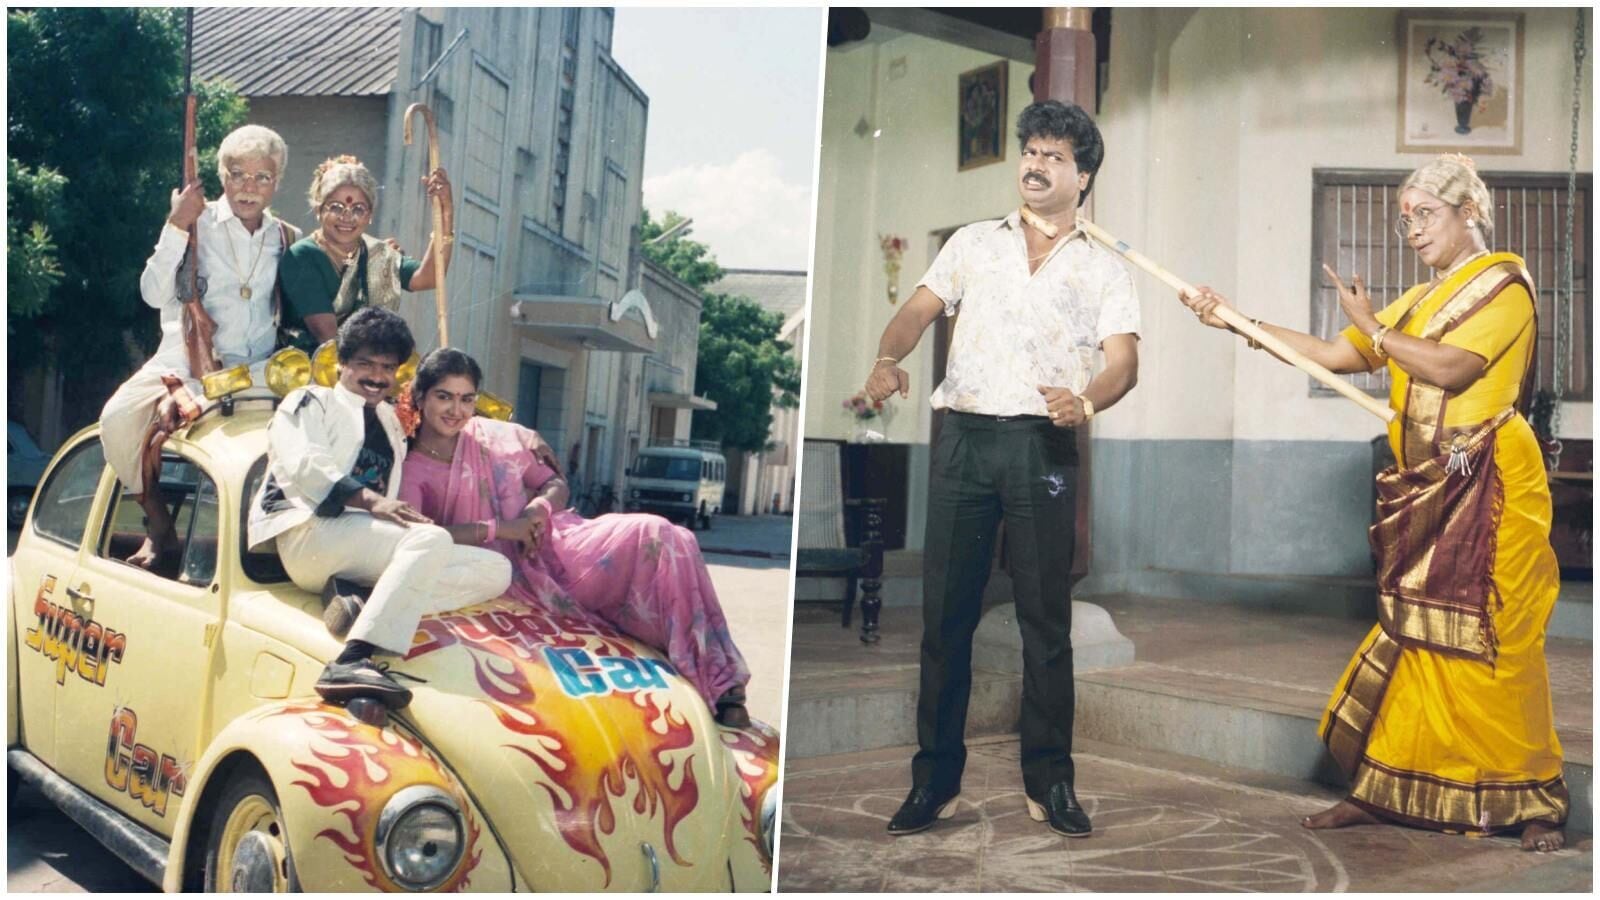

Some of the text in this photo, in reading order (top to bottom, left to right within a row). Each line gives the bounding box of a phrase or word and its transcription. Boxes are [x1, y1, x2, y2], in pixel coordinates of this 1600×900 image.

[26, 574, 127, 687] Super
[541, 645, 680, 698] Car
[104, 707, 187, 818] Car
